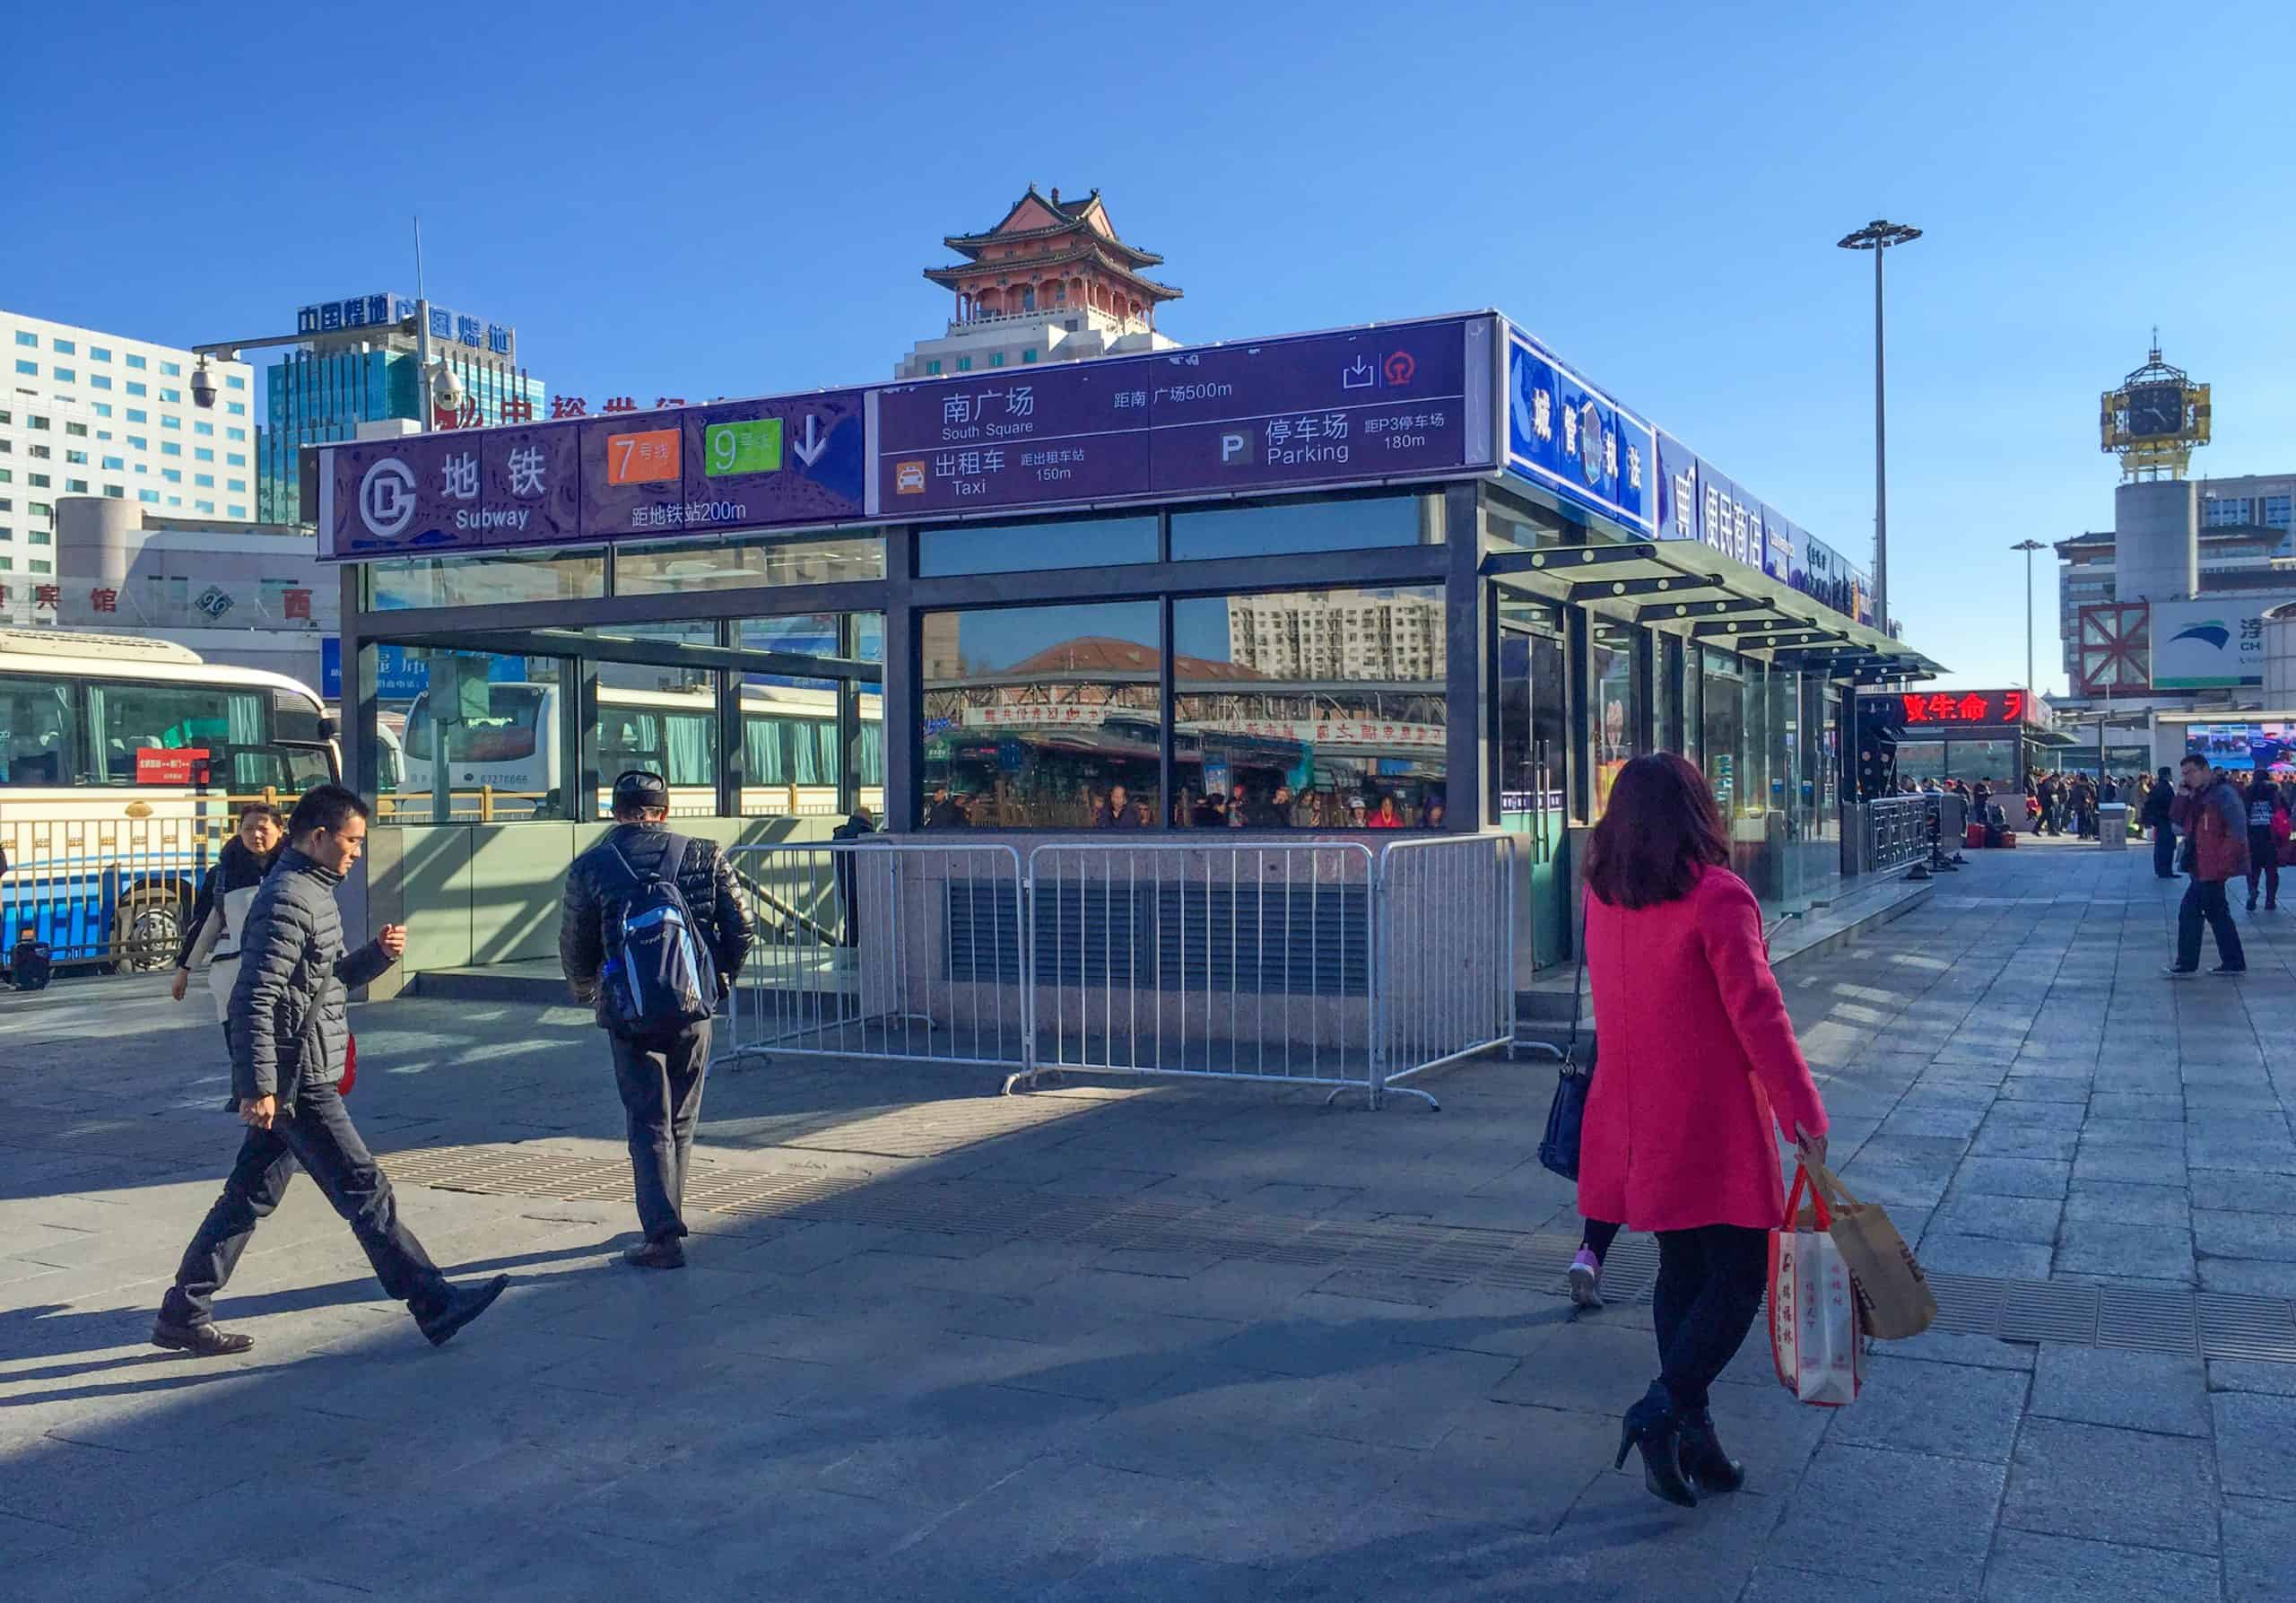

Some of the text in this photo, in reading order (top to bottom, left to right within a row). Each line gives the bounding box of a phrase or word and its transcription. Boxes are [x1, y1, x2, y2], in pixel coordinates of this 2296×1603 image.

[942, 386, 1034, 424] 南广场
[942, 423, 1034, 441] South Square
[1265, 414, 1348, 446] 停车场
[1365, 413, 1445, 433] 距P3停车场
[1384, 435, 1426, 449] 180m
[935, 449, 1005, 477] 出租车
[1021, 449, 1084, 466] 距出租车站
[1267, 445, 1349, 465] Parking
[441, 445, 547, 500] 地铁
[1037, 468, 1072, 481] 150m
[952, 478, 986, 495] Taxi
[456, 507, 530, 530] Subway
[632, 501, 746, 527] 距地铁站200m
